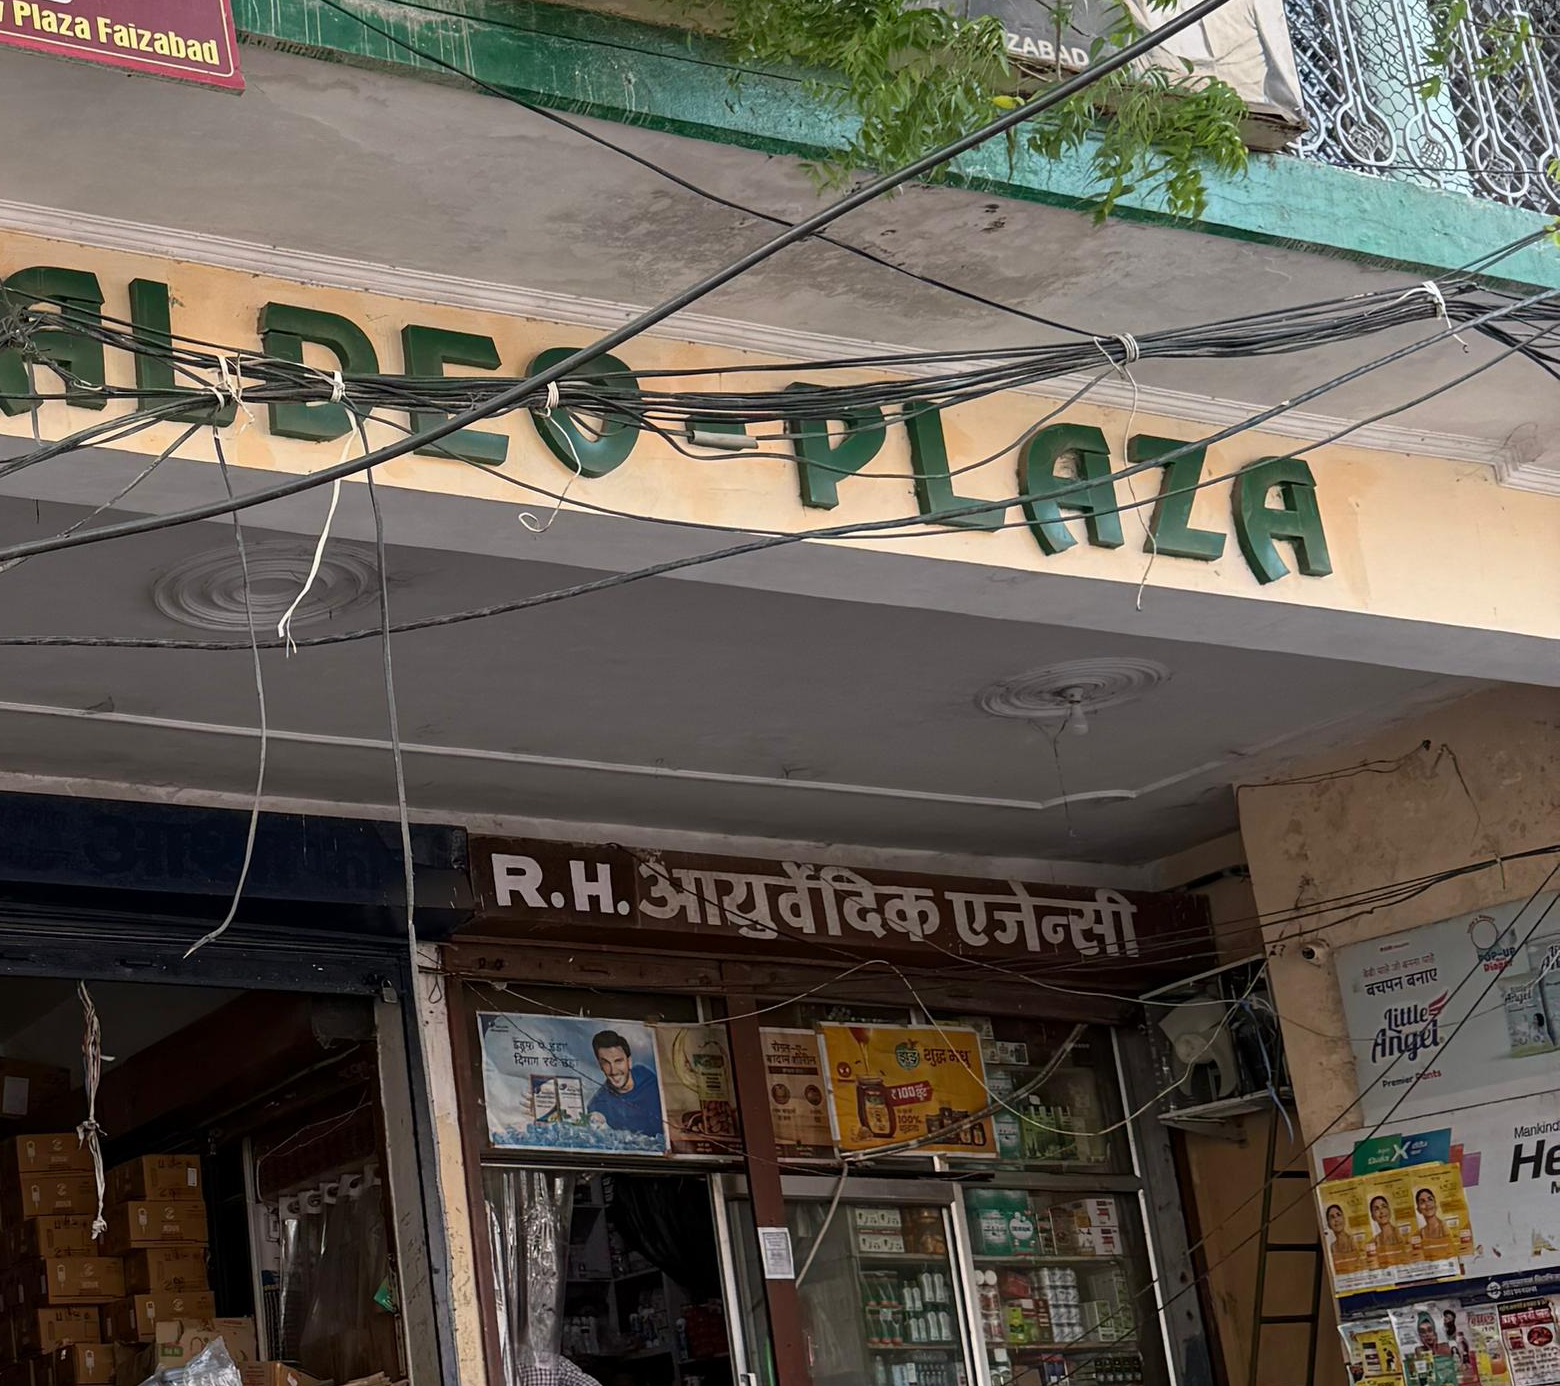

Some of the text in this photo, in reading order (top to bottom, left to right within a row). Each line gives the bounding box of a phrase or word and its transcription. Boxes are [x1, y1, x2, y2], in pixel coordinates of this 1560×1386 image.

[13, 1, 92, 42] Plaza
[96, 17, 221, 66] Faizabad
[786, 379, 1332, 586] PLAZA
[491, 852, 1140, 958] R.H. आयुर्वेदिक एजेन्सी
[1371, 1015, 1441, 1064] Angel
[1383, 1005, 1430, 1034] Little
[1382, 1075, 1415, 1089] Premier
